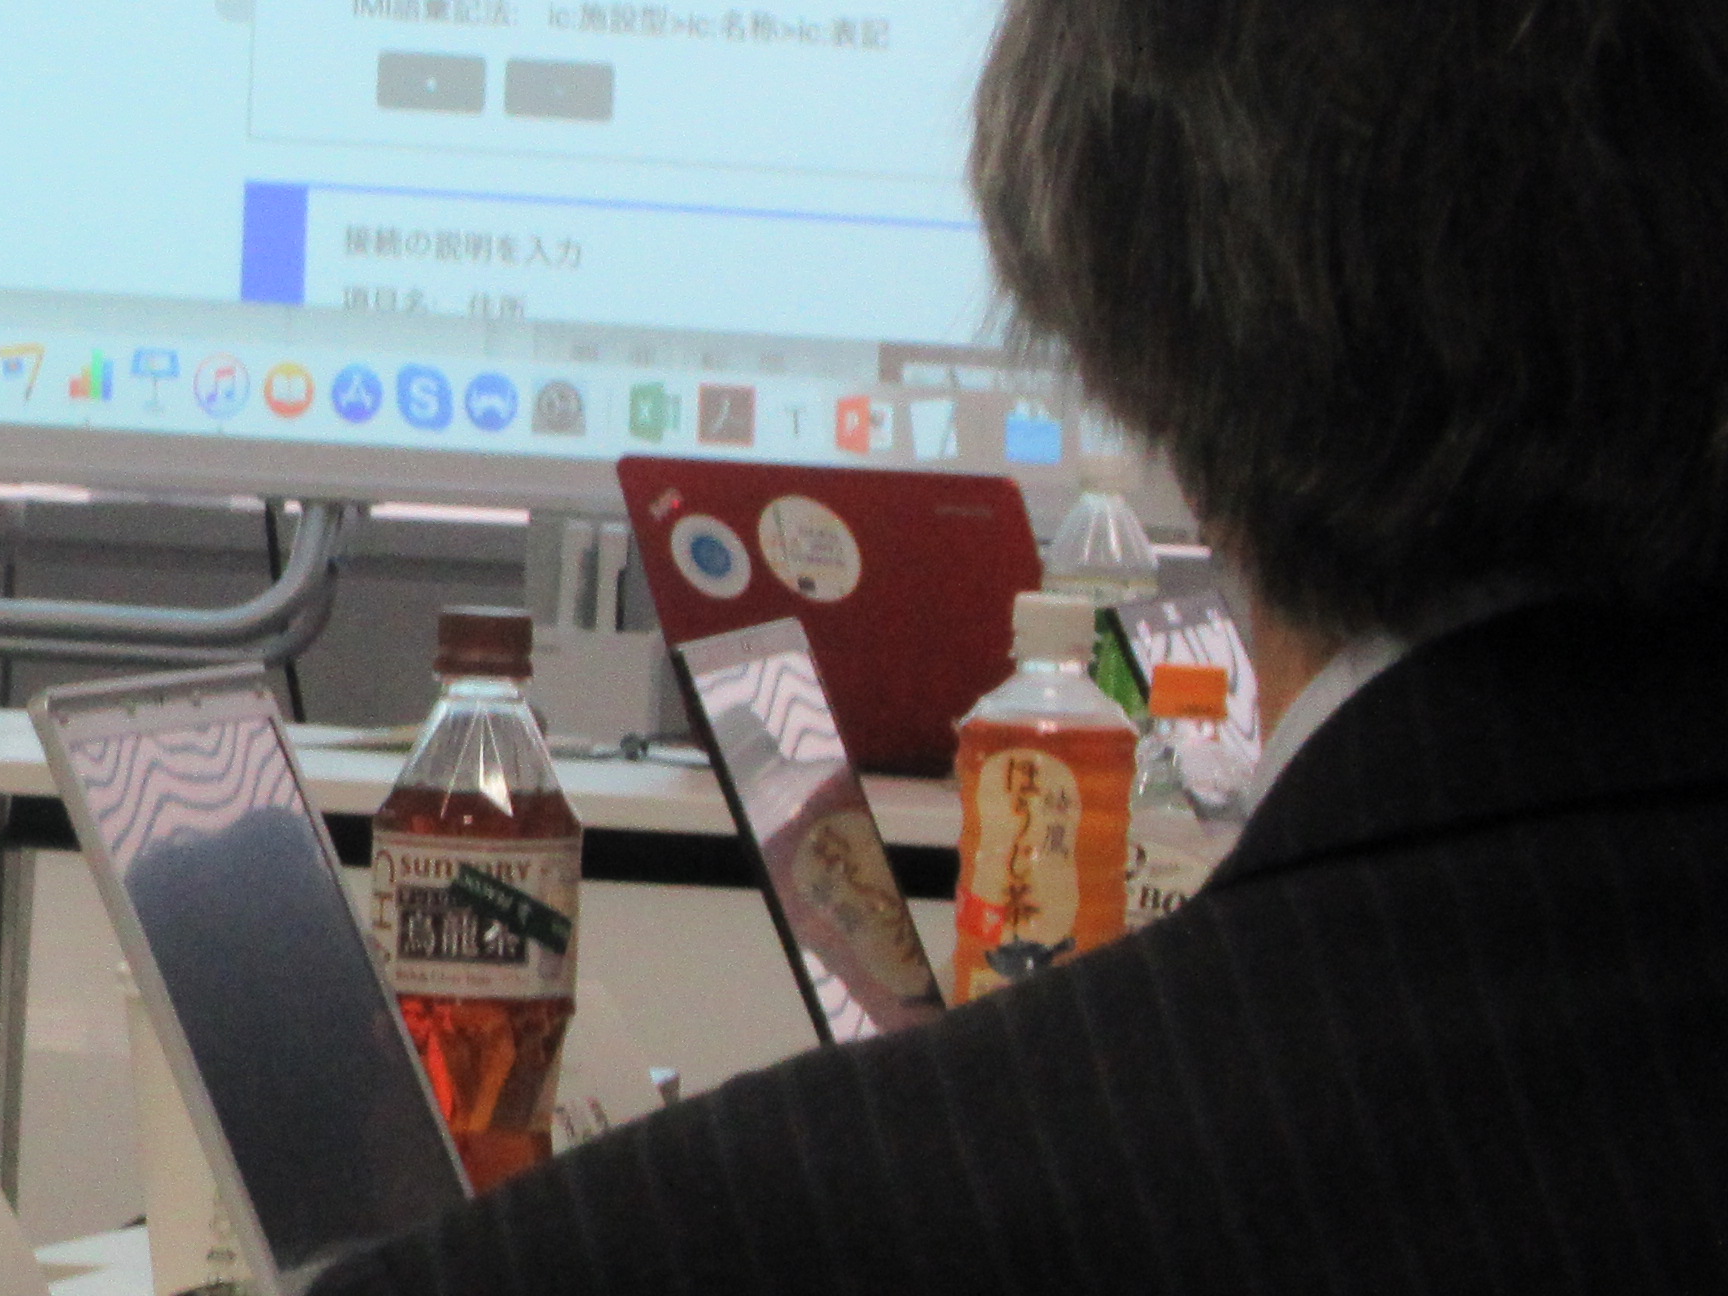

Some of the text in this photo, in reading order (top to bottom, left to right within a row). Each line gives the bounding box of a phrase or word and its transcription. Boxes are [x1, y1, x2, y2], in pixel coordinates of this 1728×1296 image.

[344, 222, 584, 270] 接続の説明を入力
